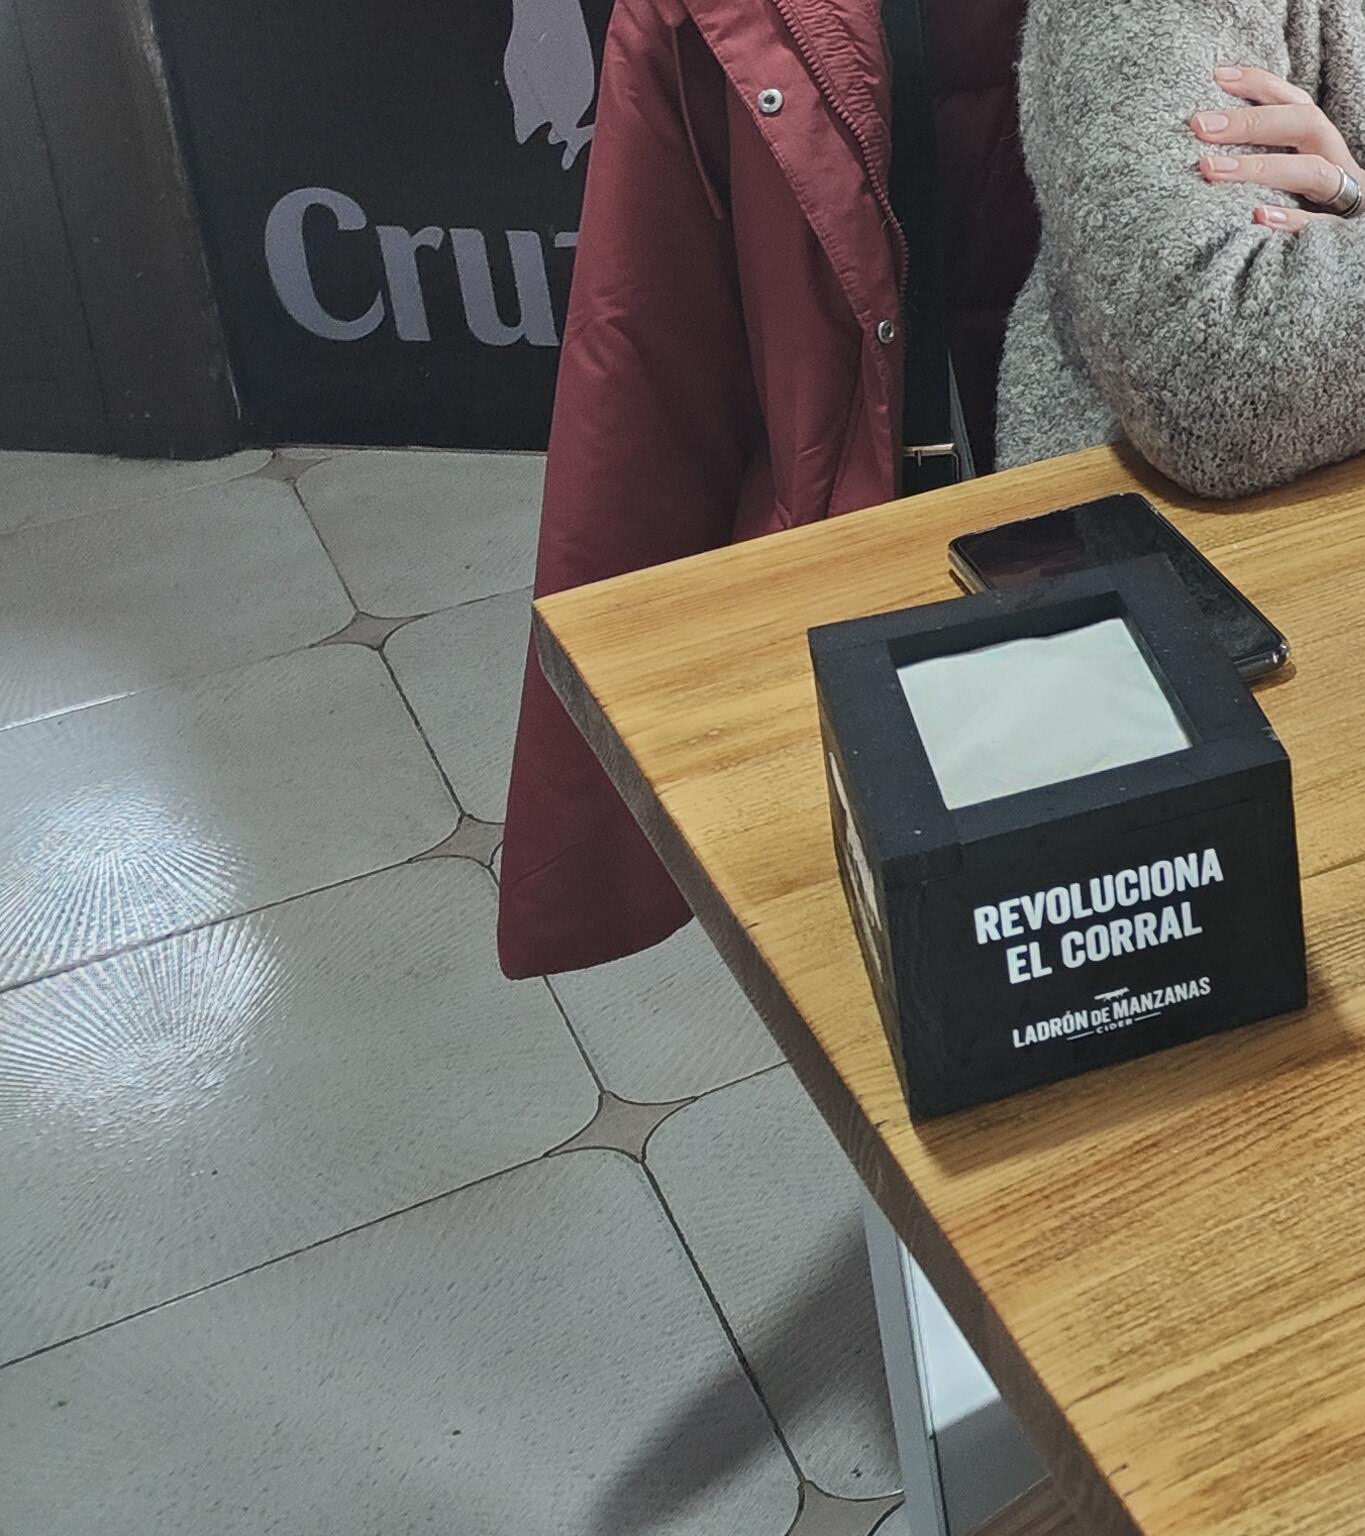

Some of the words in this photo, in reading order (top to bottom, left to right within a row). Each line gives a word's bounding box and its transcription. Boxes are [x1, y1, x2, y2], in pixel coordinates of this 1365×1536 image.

[265, 186, 579, 347] Cru
[973, 848, 1224, 945] REVOLUCIONA
[1006, 941, 1053, 985] EL
[1061, 901, 1203, 970] CORRAL
[1012, 1009, 1090, 1049] LADRÓN
[1091, 1008, 1112, 1027] DE
[1112, 976, 1212, 1021] MANZANAS
[1095, 1018, 1134, 1034] CIDER
